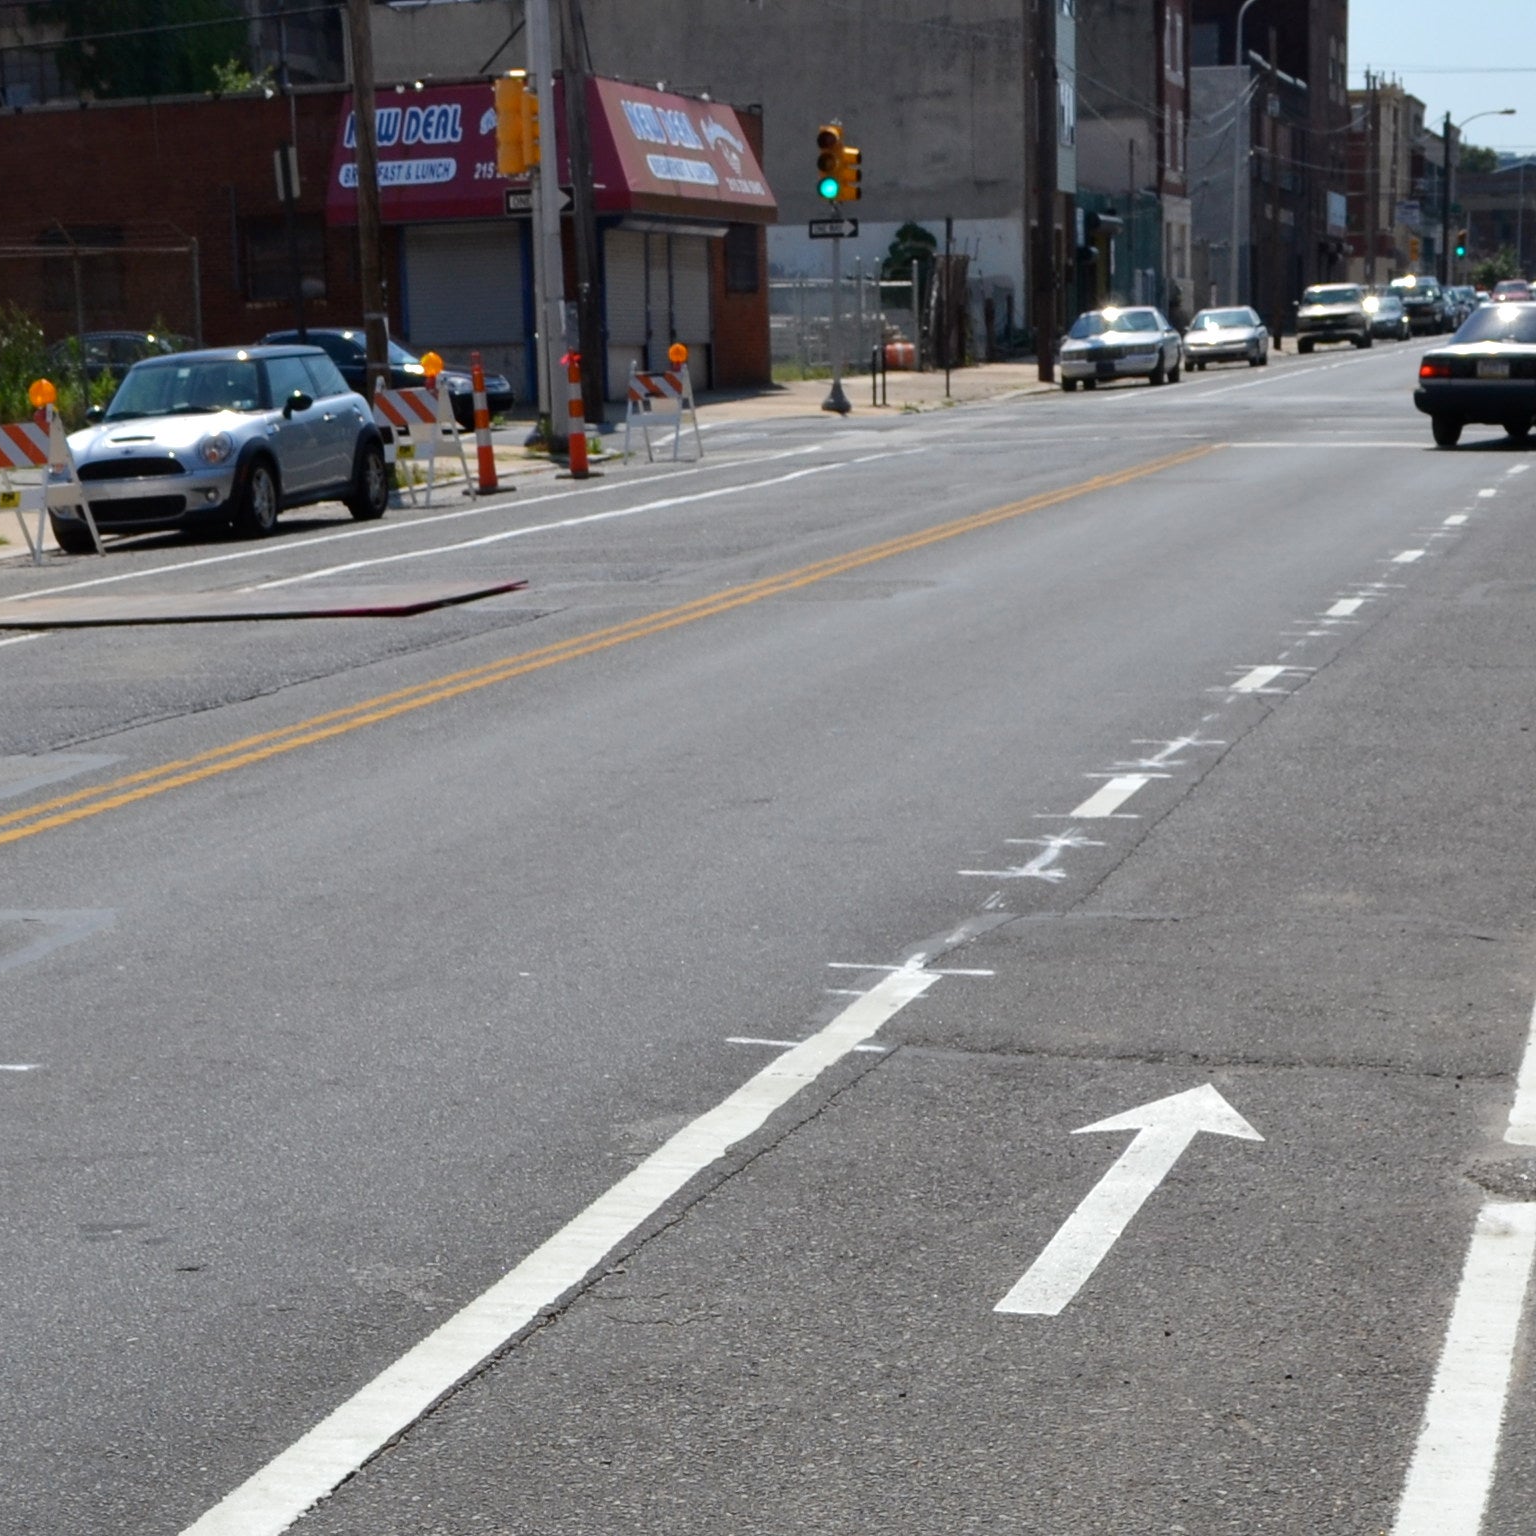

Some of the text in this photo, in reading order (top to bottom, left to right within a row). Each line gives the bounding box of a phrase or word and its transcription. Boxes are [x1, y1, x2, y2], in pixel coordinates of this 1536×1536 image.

[402, 104, 462, 144] DEAL
[405, 164, 412, 180] &
[415, 161, 451, 180] LUNCH
[474, 162, 495, 179] 215
